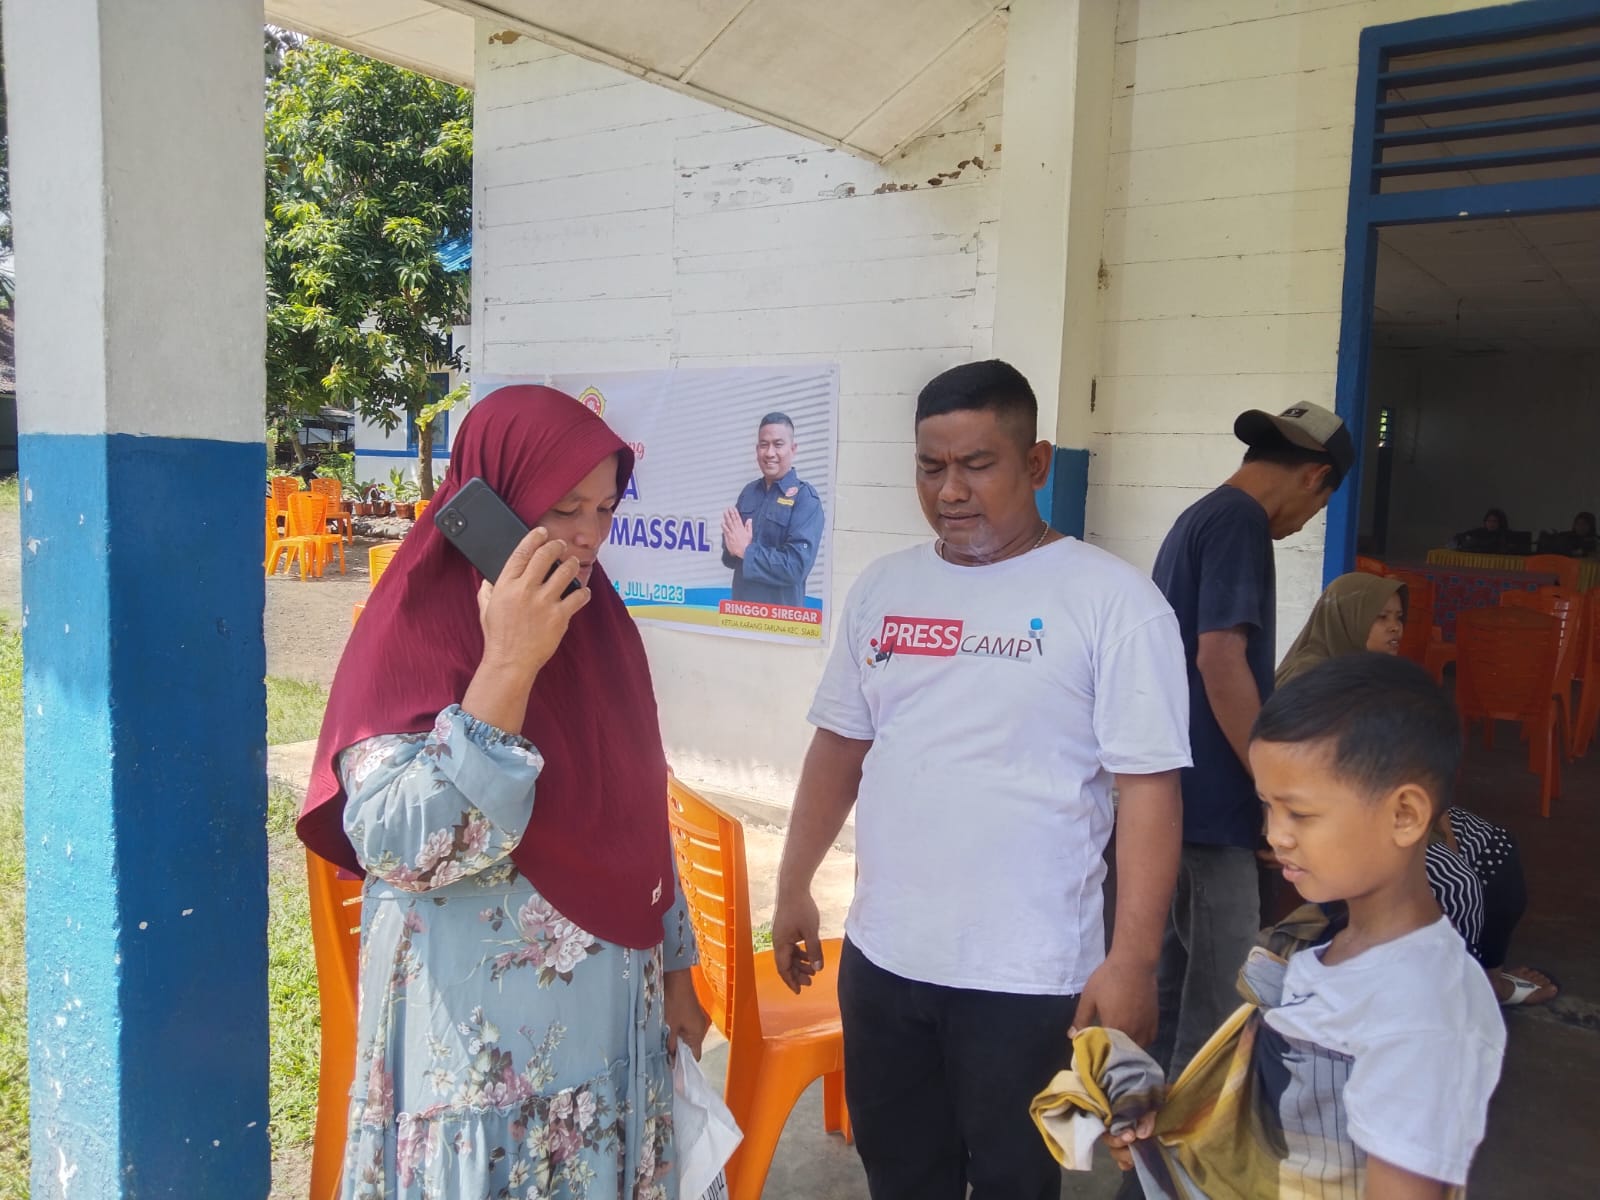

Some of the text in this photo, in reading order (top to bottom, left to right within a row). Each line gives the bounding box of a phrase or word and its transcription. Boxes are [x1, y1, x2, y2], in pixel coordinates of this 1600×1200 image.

[610, 516, 711, 552] MASSAL
[724, 603, 818, 623] RINGGO SIREGAR
[740, 620, 763, 630] KARANG
[882, 622, 1032, 658] PRESS CAMP
